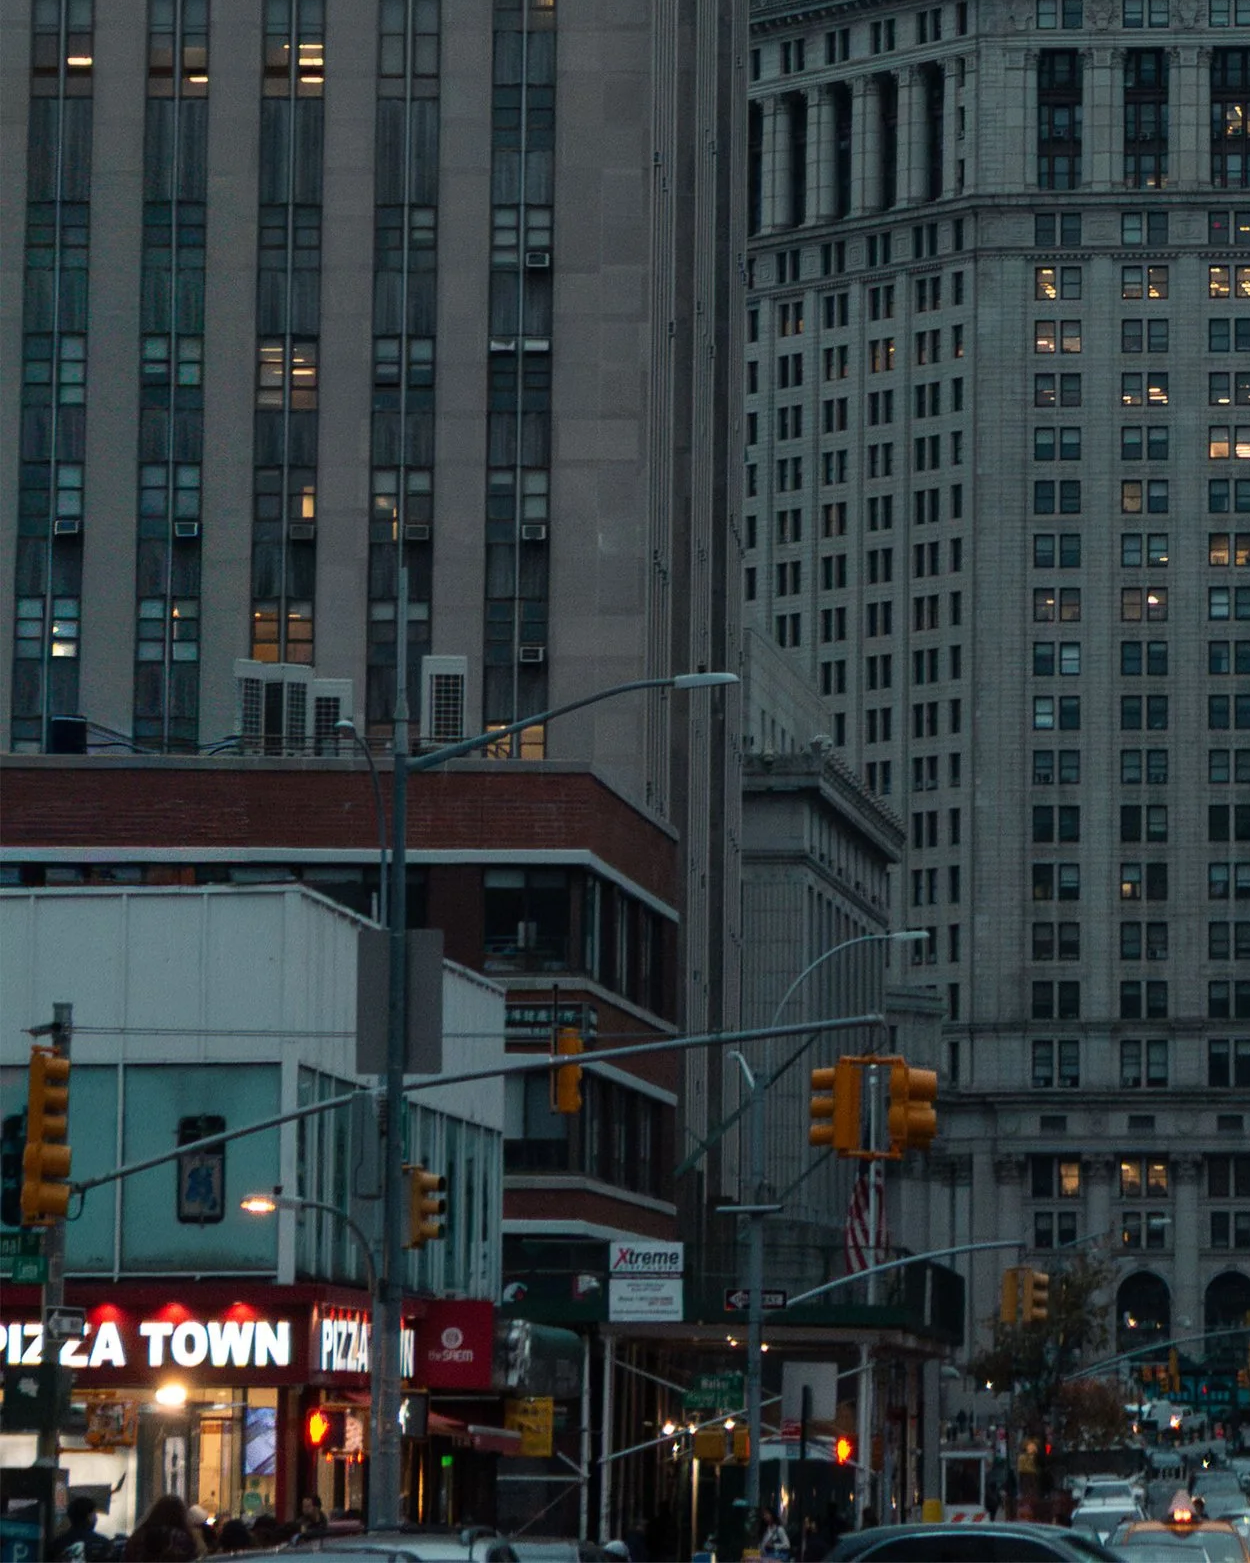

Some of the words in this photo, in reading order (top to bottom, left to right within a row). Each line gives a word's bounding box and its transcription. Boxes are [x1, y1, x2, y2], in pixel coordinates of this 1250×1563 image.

[613, 1248, 679, 1269] Xtreme
[0, 1321, 127, 1367] IZZA
[139, 1321, 291, 1367] TOWN
[321, 1318, 369, 1373] PIZZA
